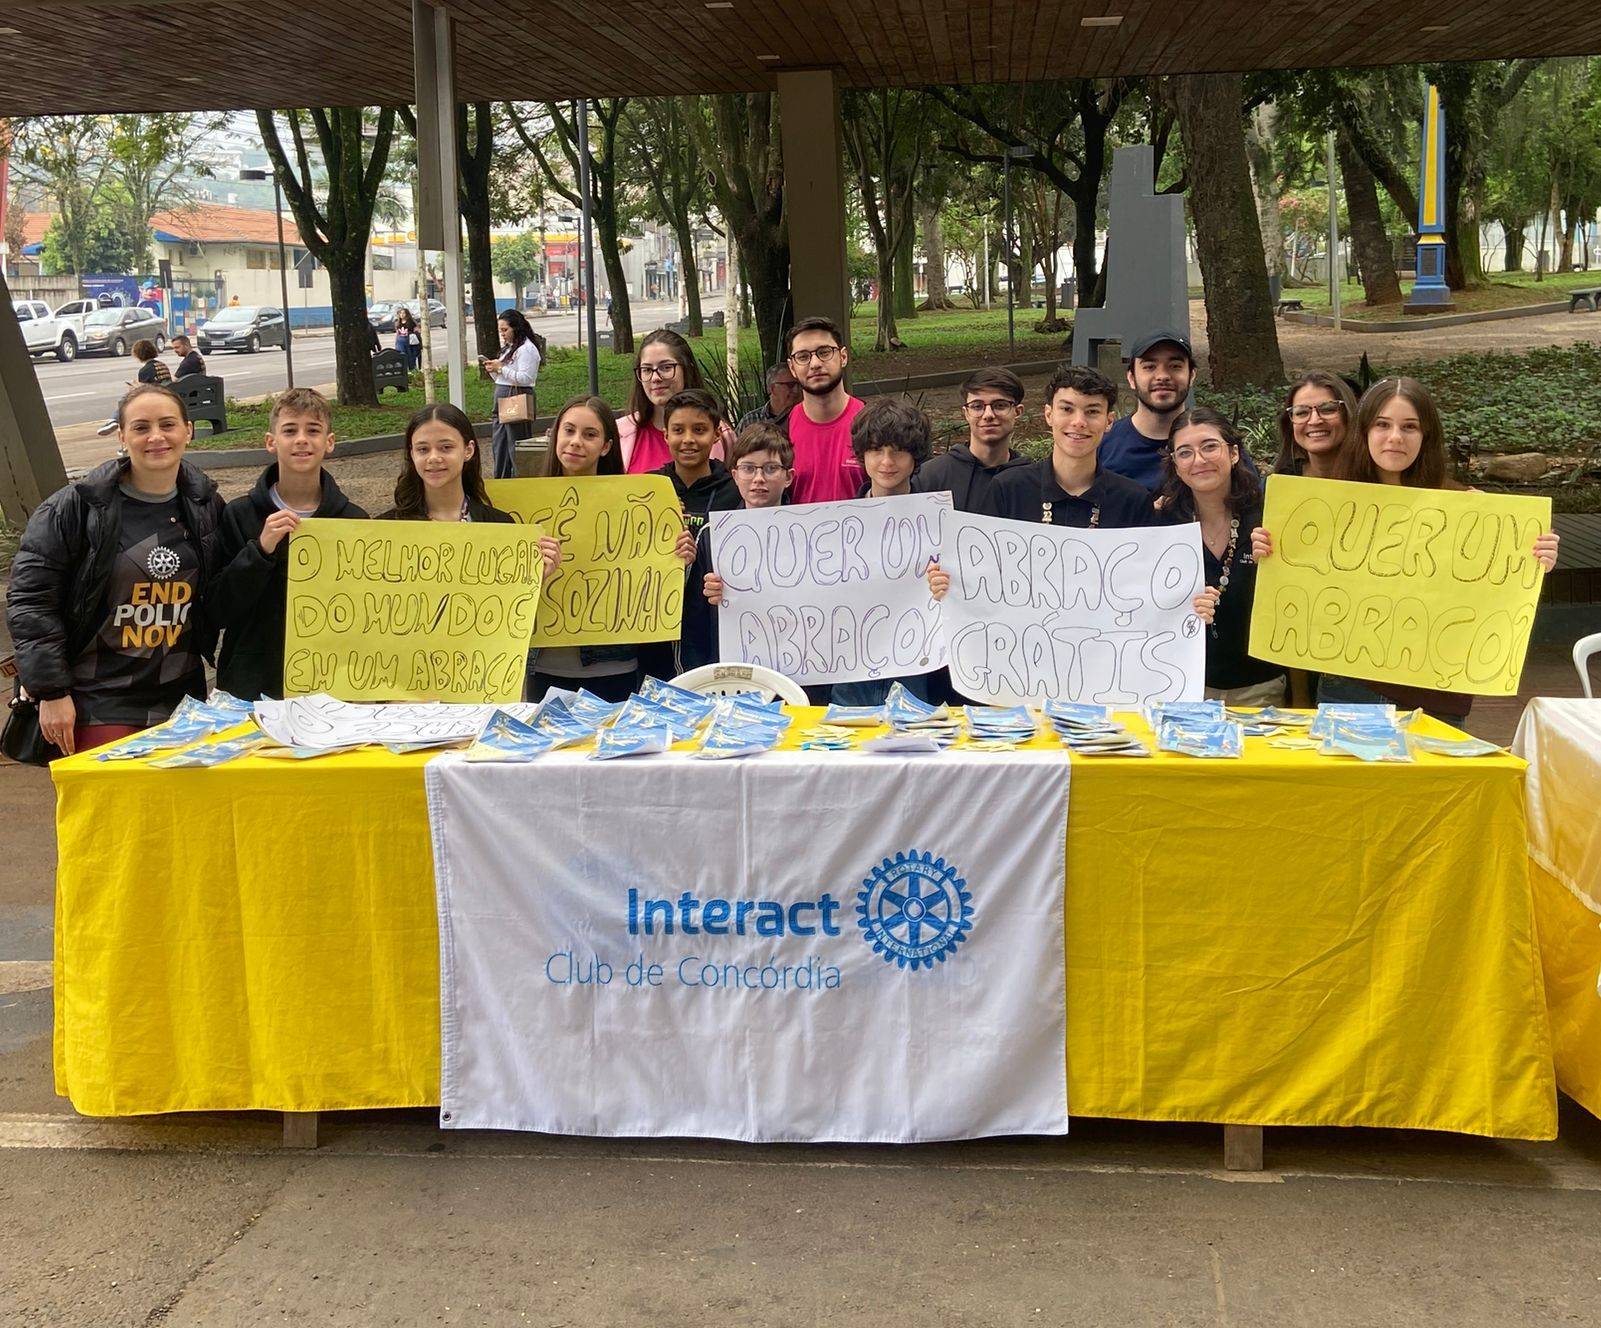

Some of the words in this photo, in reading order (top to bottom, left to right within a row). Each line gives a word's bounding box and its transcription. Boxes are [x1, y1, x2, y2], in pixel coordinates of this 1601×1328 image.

[591, 491, 685, 562] NÃO
[717, 516, 869, 593] QUER
[1280, 498, 1447, 577] QUER
[1451, 511, 1542, 590] UM
[288, 535, 322, 582] O
[336, 539, 455, 582] MELHOR
[460, 540, 543, 585] LUGAR
[957, 526, 1199, 626] ABRAÇO
[131, 581, 192, 606] END
[293, 593, 355, 638] DO
[363, 592, 504, 637] MUNDO
[507, 585, 539, 640] É
[540, 566, 685, 638] SOZINHO
[951, 611, 1187, 704] GRÁTIS
[1270, 584, 1535, 692] ABRAÇO?
[285, 648, 338, 693] EM
[348, 650, 399, 691] UM
[406, 649, 523, 704] ABRAÇO
[890, 863, 940, 878] ROTARY
[626, 887, 841, 938] Interact
[545, 951, 613, 986] Club
[625, 954, 664, 987] de
[677, 955, 841, 990] Concórdia
[874, 927, 957, 959] INTERNATIONAL
